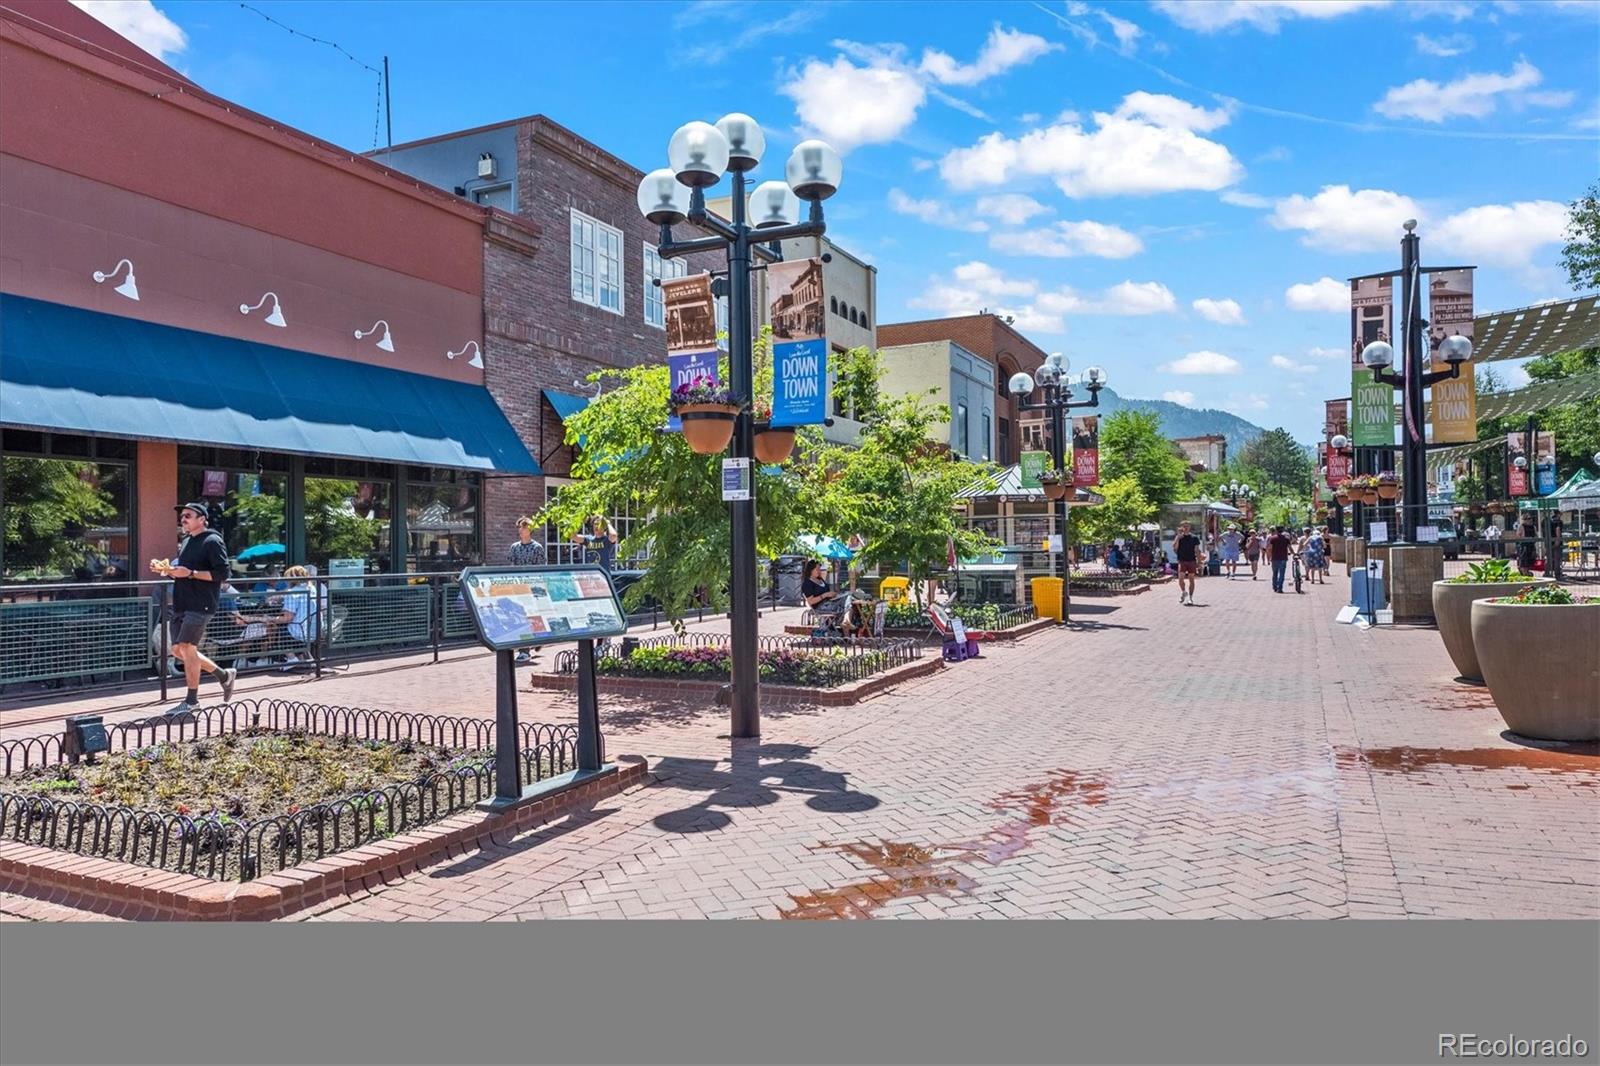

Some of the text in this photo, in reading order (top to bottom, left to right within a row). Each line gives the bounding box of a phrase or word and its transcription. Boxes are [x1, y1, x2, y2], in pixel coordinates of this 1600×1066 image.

[782, 355, 819, 379] DOWN
[782, 376, 819, 400] TOWN
[1357, 387, 1389, 406] DOWN
[1436, 383, 1470, 403] DOWN
[1357, 405, 1390, 424] TOWN
[1437, 401, 1470, 421] TOWN
[1077, 456, 1096, 466] DOWN
[1077, 465, 1096, 475] TOWN
[1328, 456, 1346, 467] DOWN
[1328, 466, 1346, 477] TOWN
